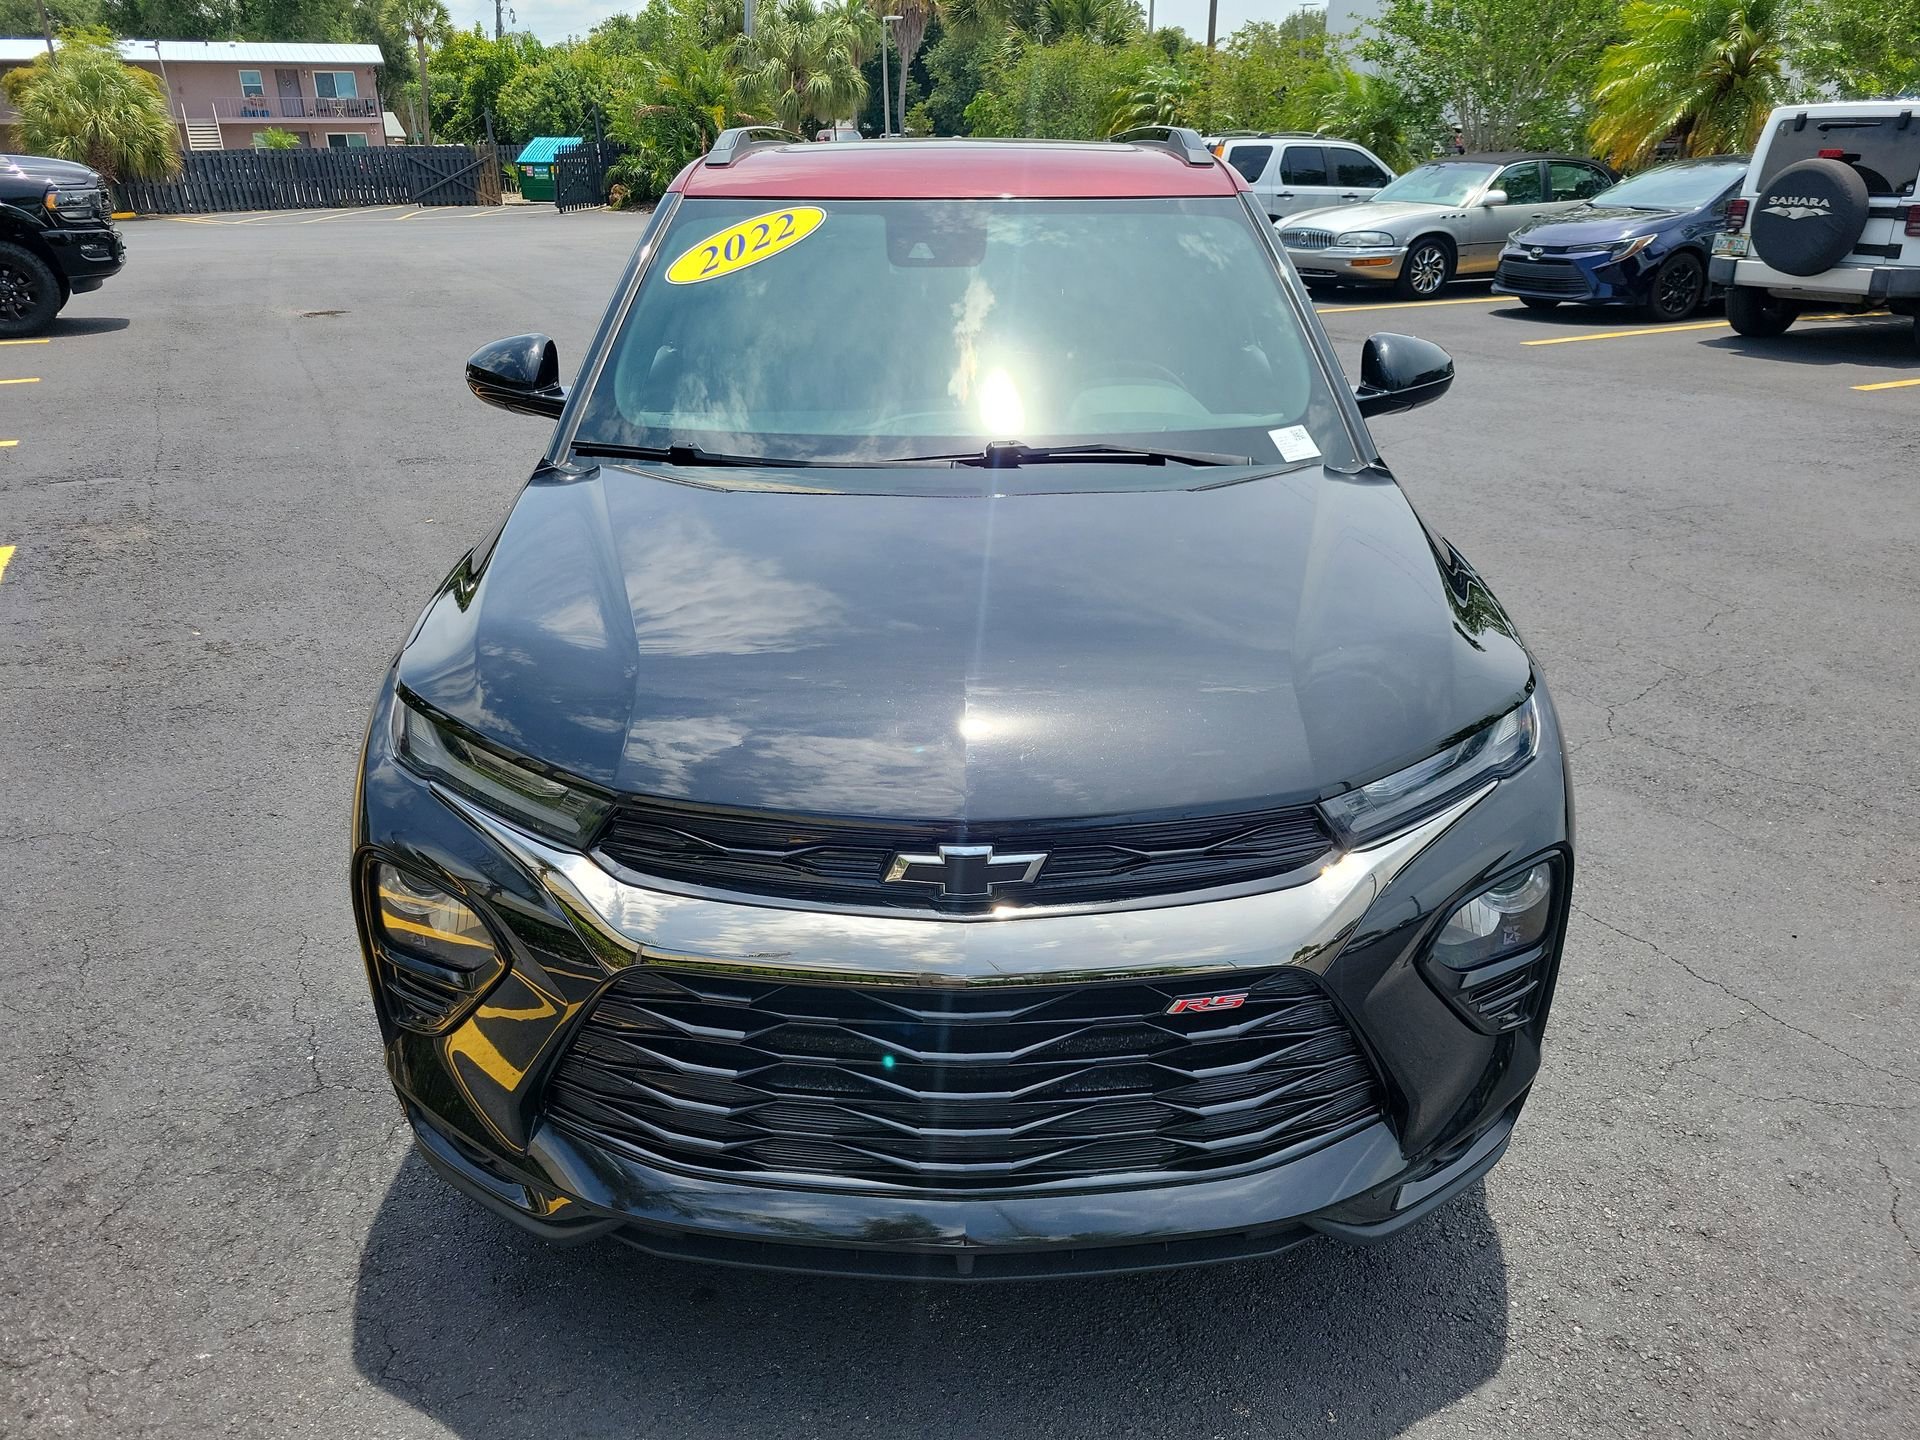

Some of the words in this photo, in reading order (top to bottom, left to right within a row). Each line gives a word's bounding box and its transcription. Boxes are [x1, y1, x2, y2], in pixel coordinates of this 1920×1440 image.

[1769, 196, 1830, 207] SAHARA
[700, 213, 796, 275] 2022
[1167, 993, 1249, 1014] RS
